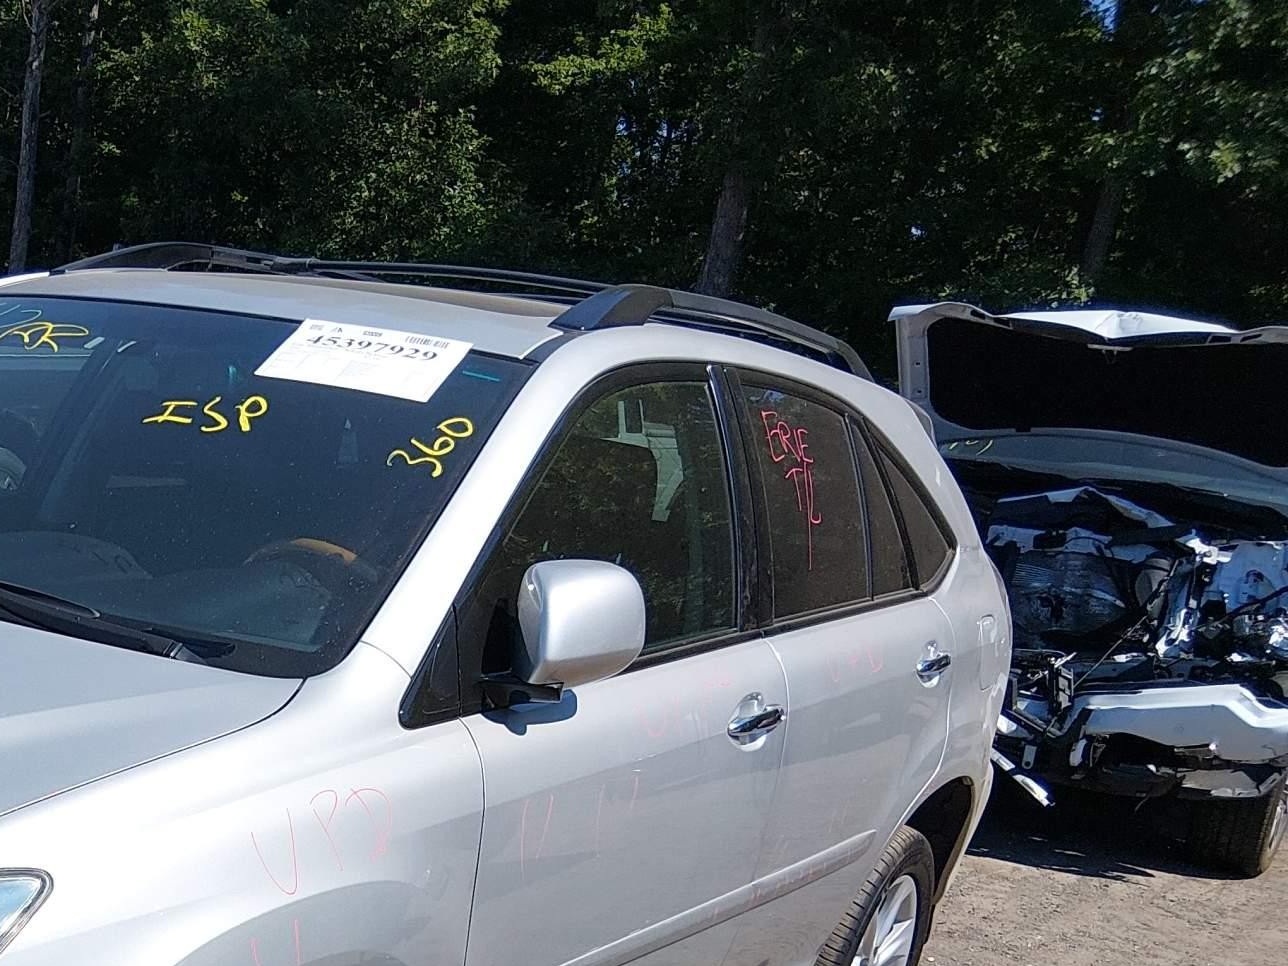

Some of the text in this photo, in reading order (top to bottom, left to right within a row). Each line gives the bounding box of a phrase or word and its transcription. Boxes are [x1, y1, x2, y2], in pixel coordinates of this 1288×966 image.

[306, 335, 438, 361] 45397929
[142, 395, 268, 432] ISP
[386, 417, 474, 478] 360
[761, 410, 815, 463] ERIE
